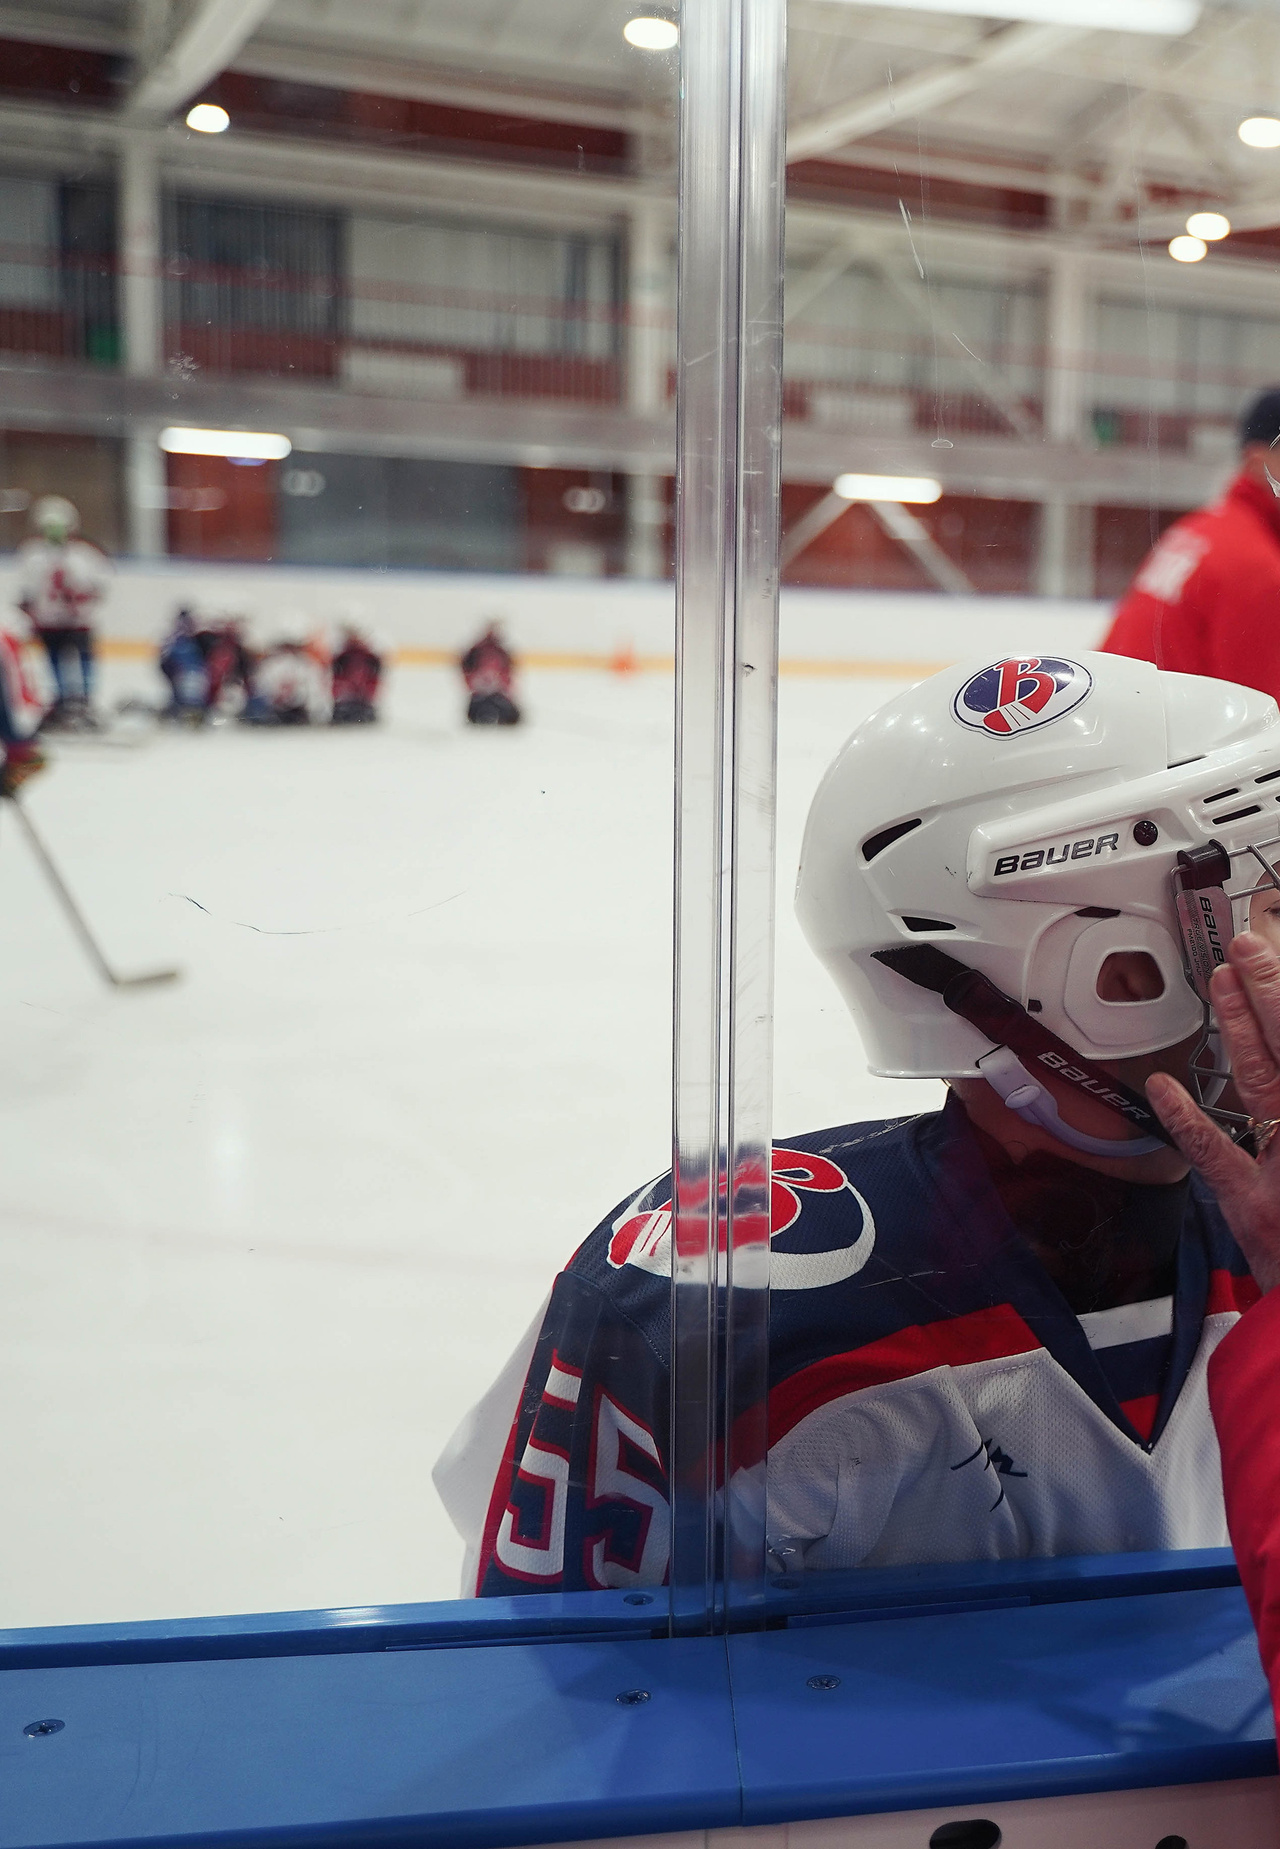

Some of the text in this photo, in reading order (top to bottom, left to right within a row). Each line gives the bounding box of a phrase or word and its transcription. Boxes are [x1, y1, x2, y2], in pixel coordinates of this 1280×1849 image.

[993, 832, 1120, 877] BAUER
[1198, 896, 1225, 966] BAUE
[1036, 1051, 1151, 1120] BAUER
[493, 1348, 671, 1591] 55
